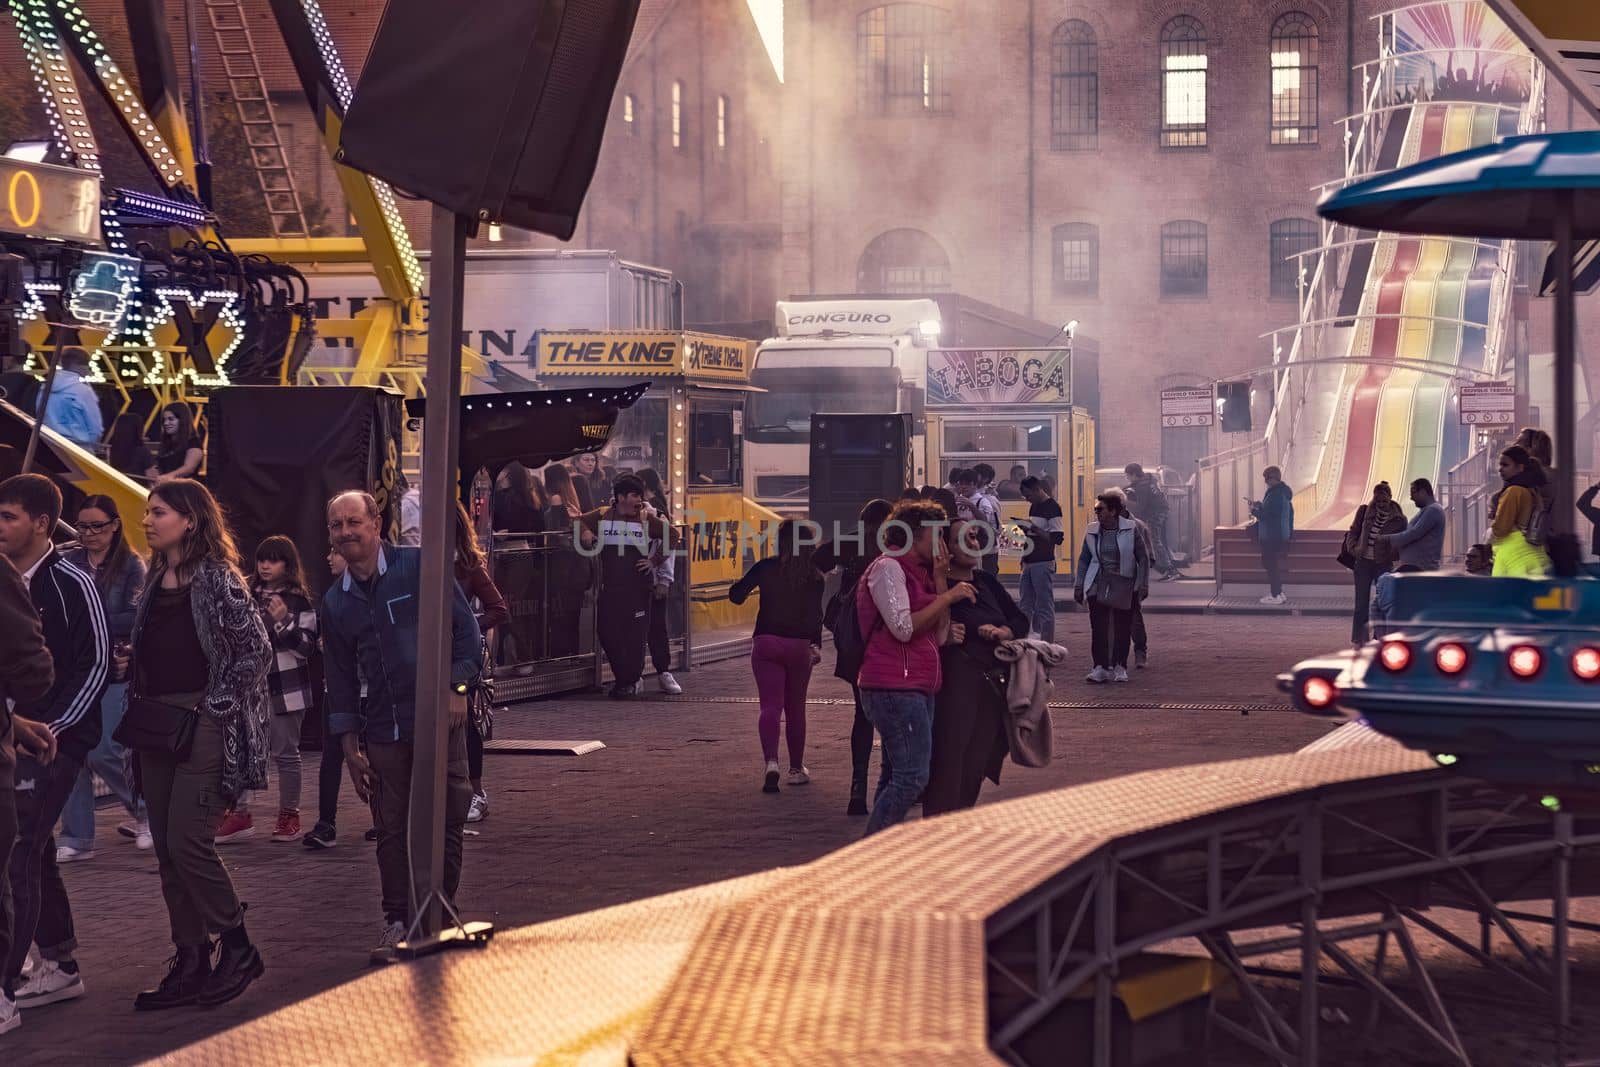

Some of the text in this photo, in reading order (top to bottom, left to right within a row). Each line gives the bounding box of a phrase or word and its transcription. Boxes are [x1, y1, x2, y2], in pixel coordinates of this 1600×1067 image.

[789, 313, 891, 325] CANGURO
[547, 341, 676, 362] THE KING
[934, 356, 1064, 398] TABOGA
